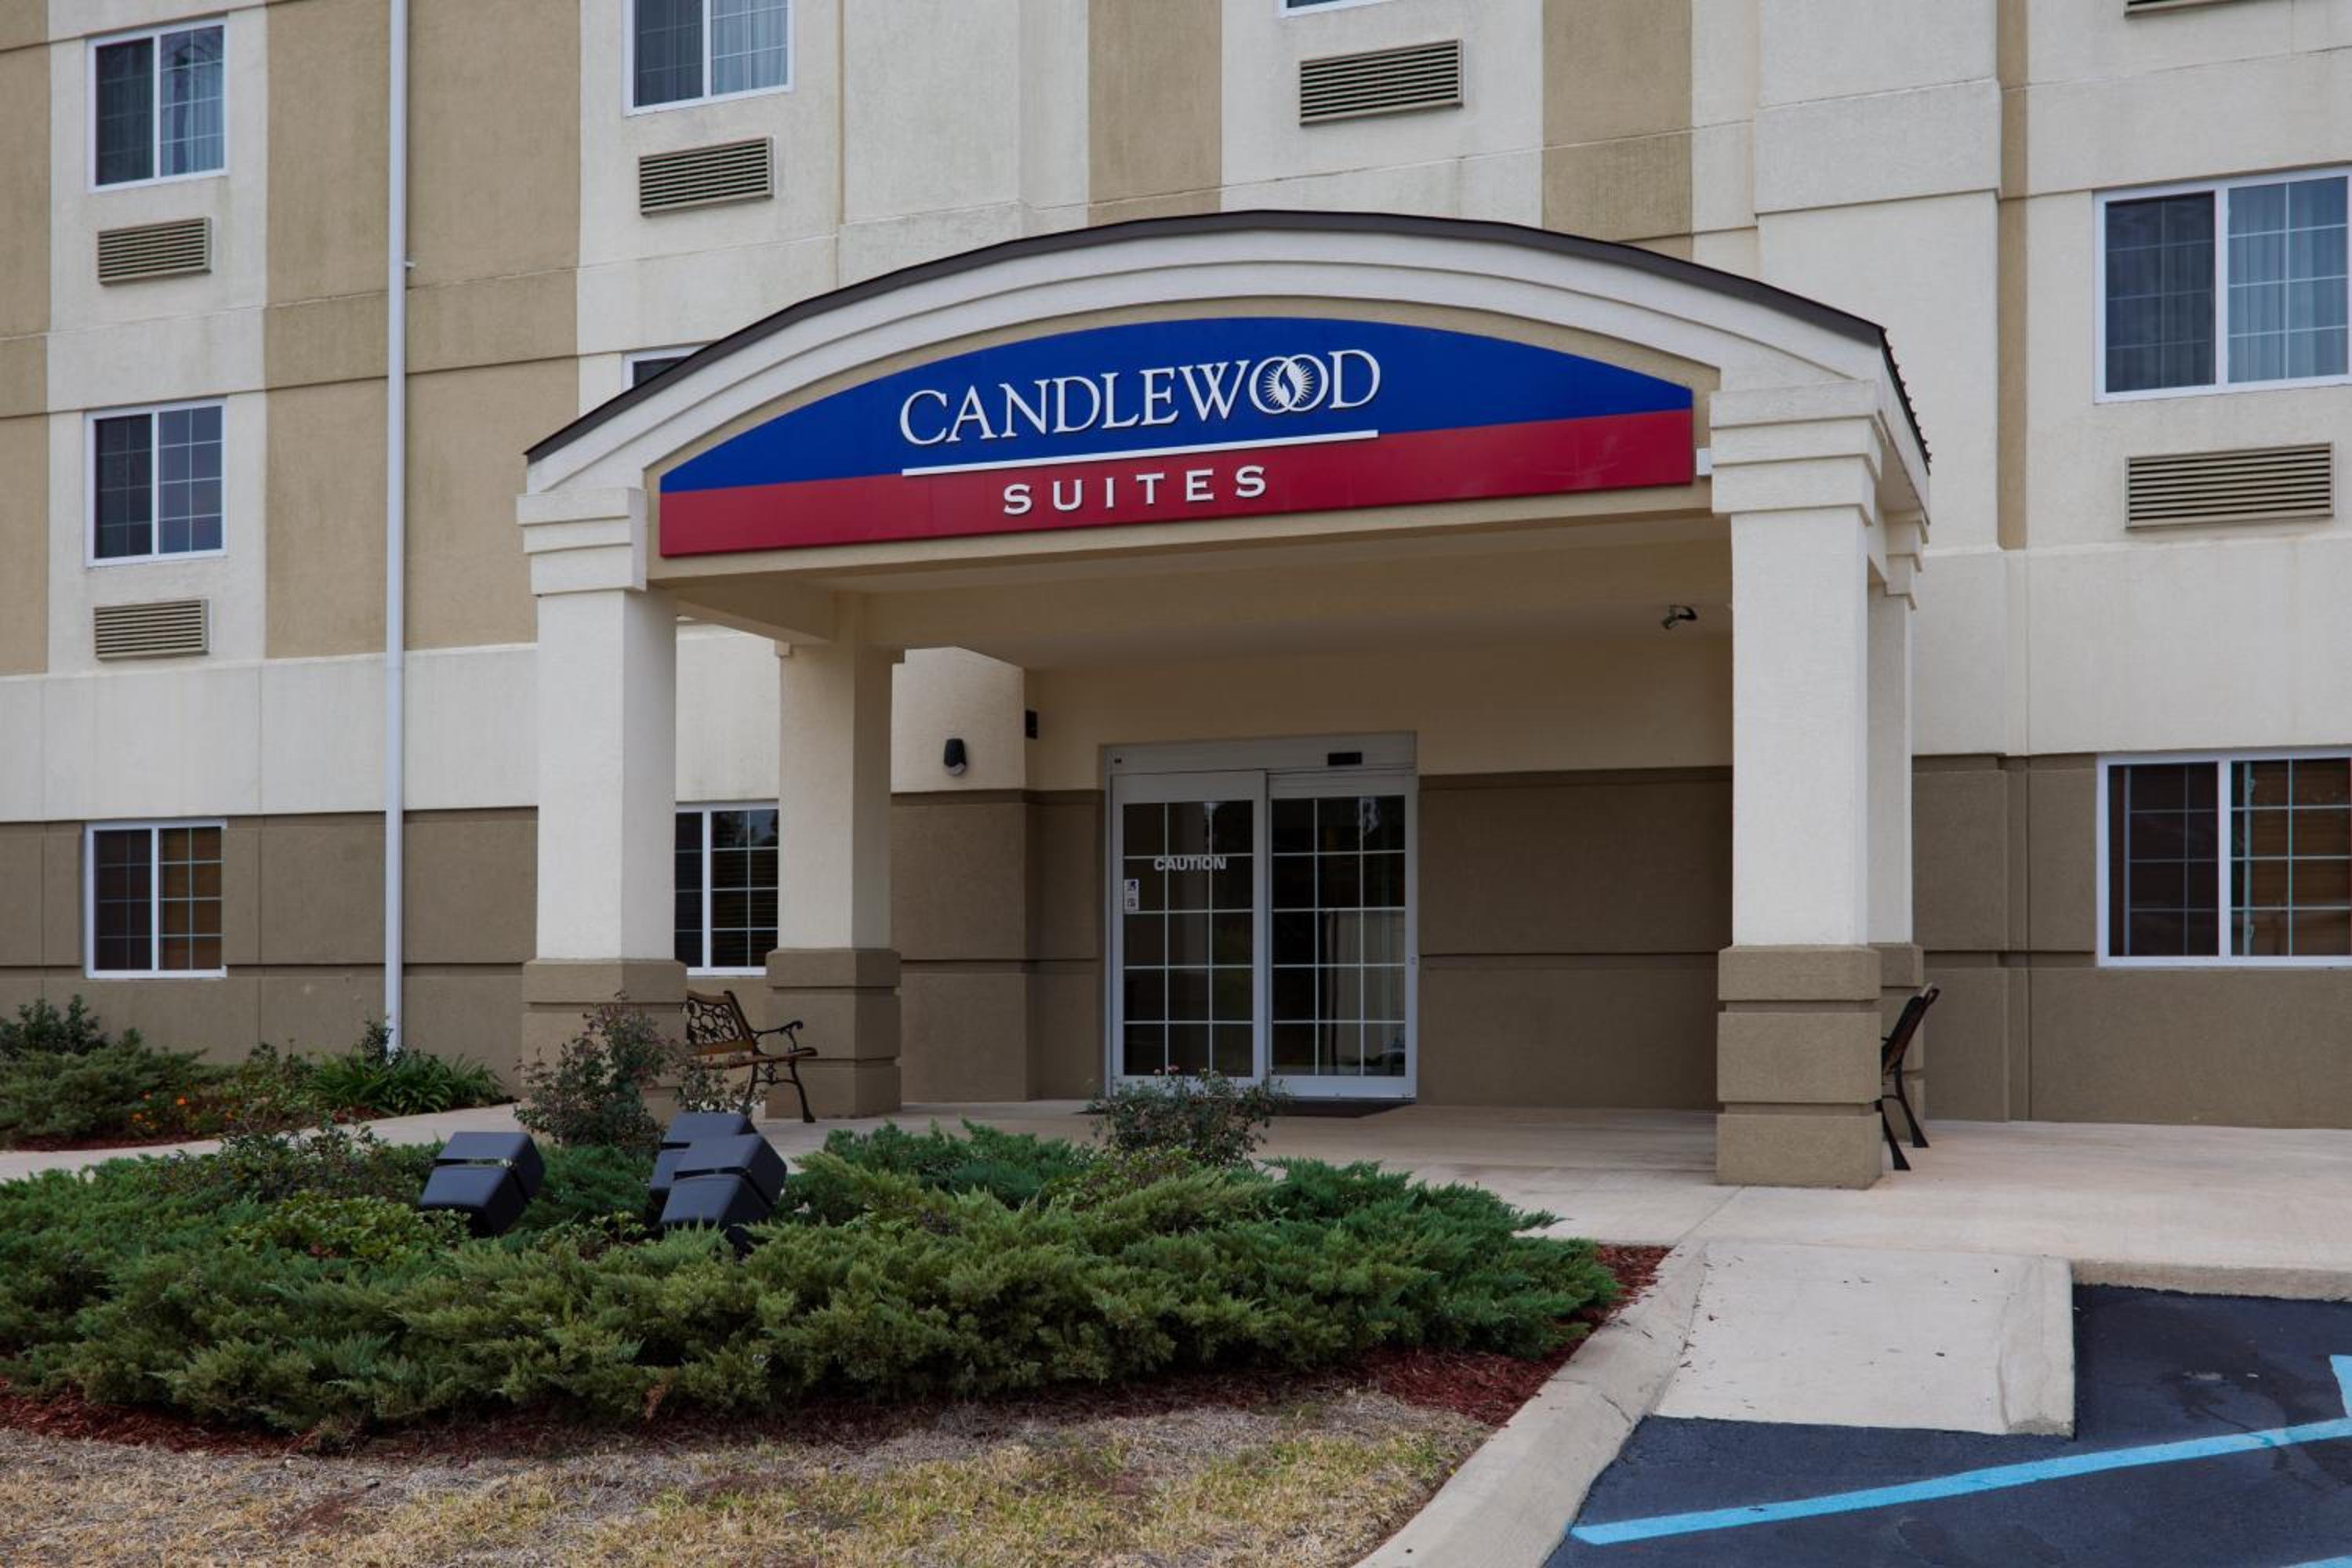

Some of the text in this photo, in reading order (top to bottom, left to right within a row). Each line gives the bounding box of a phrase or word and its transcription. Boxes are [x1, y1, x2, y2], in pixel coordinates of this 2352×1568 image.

[899, 349, 1381, 445] CANDLEWOOD
[1002, 465, 1267, 515] SUITES
[1153, 856, 1228, 871] CAUTION
